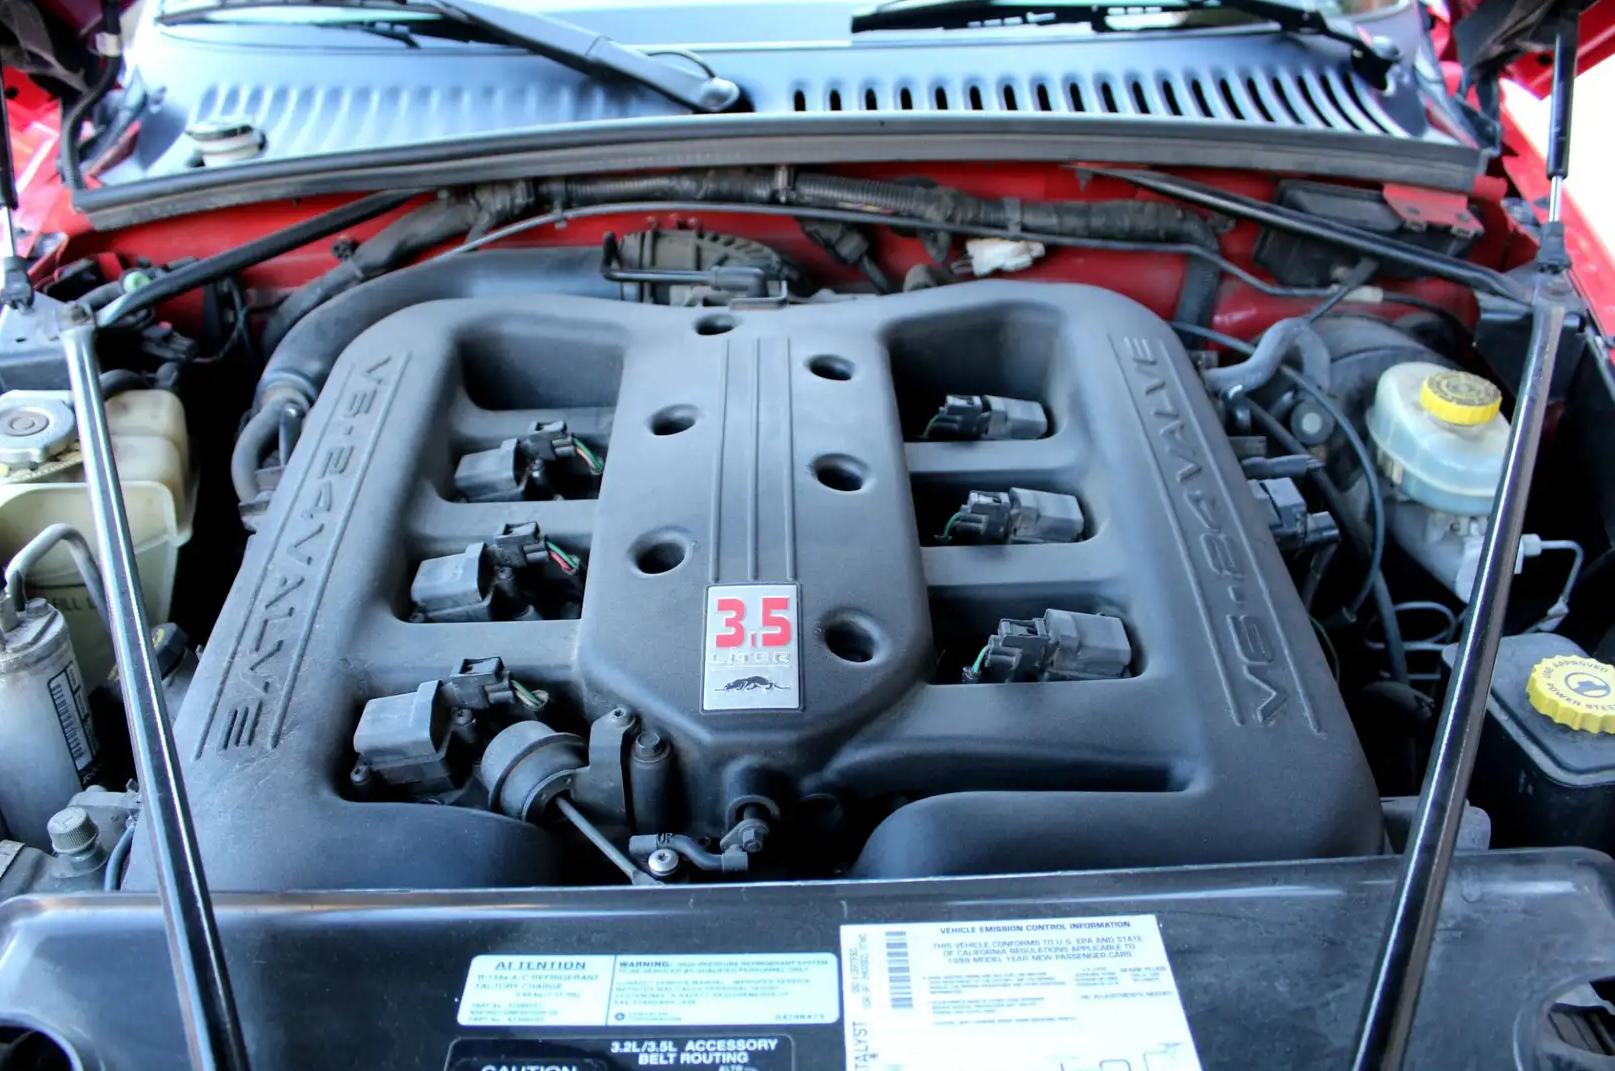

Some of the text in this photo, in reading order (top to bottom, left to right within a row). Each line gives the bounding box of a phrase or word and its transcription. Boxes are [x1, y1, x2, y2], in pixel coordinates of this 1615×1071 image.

[715, 597, 791, 648] 3.5
[1546, 683, 1581, 706] POWER
[979, 925, 1023, 933] EMISSION
[1026, 923, 1066, 931] CONTROL
[1069, 921, 1131, 930] INFORMATION
[954, 941, 988, 949] VEHICLE
[992, 939, 1040, 948] CONFORMS
[957, 948, 1007, 956] CALIFORNIA
[1010, 946, 1068, 955] REGULATIONS
[1071, 944, 1121, 953] APPLICABLE
[1055, 952, 1106, 960] PASSENGER
[494, 961, 586, 970] ATTENTION
[610, 1039, 779, 1053] 3.2L/3.5L ACCESSORY
[852, 1020, 869, 1071] TALYST
[638, 1052, 749, 1065] BELT ROUTING
